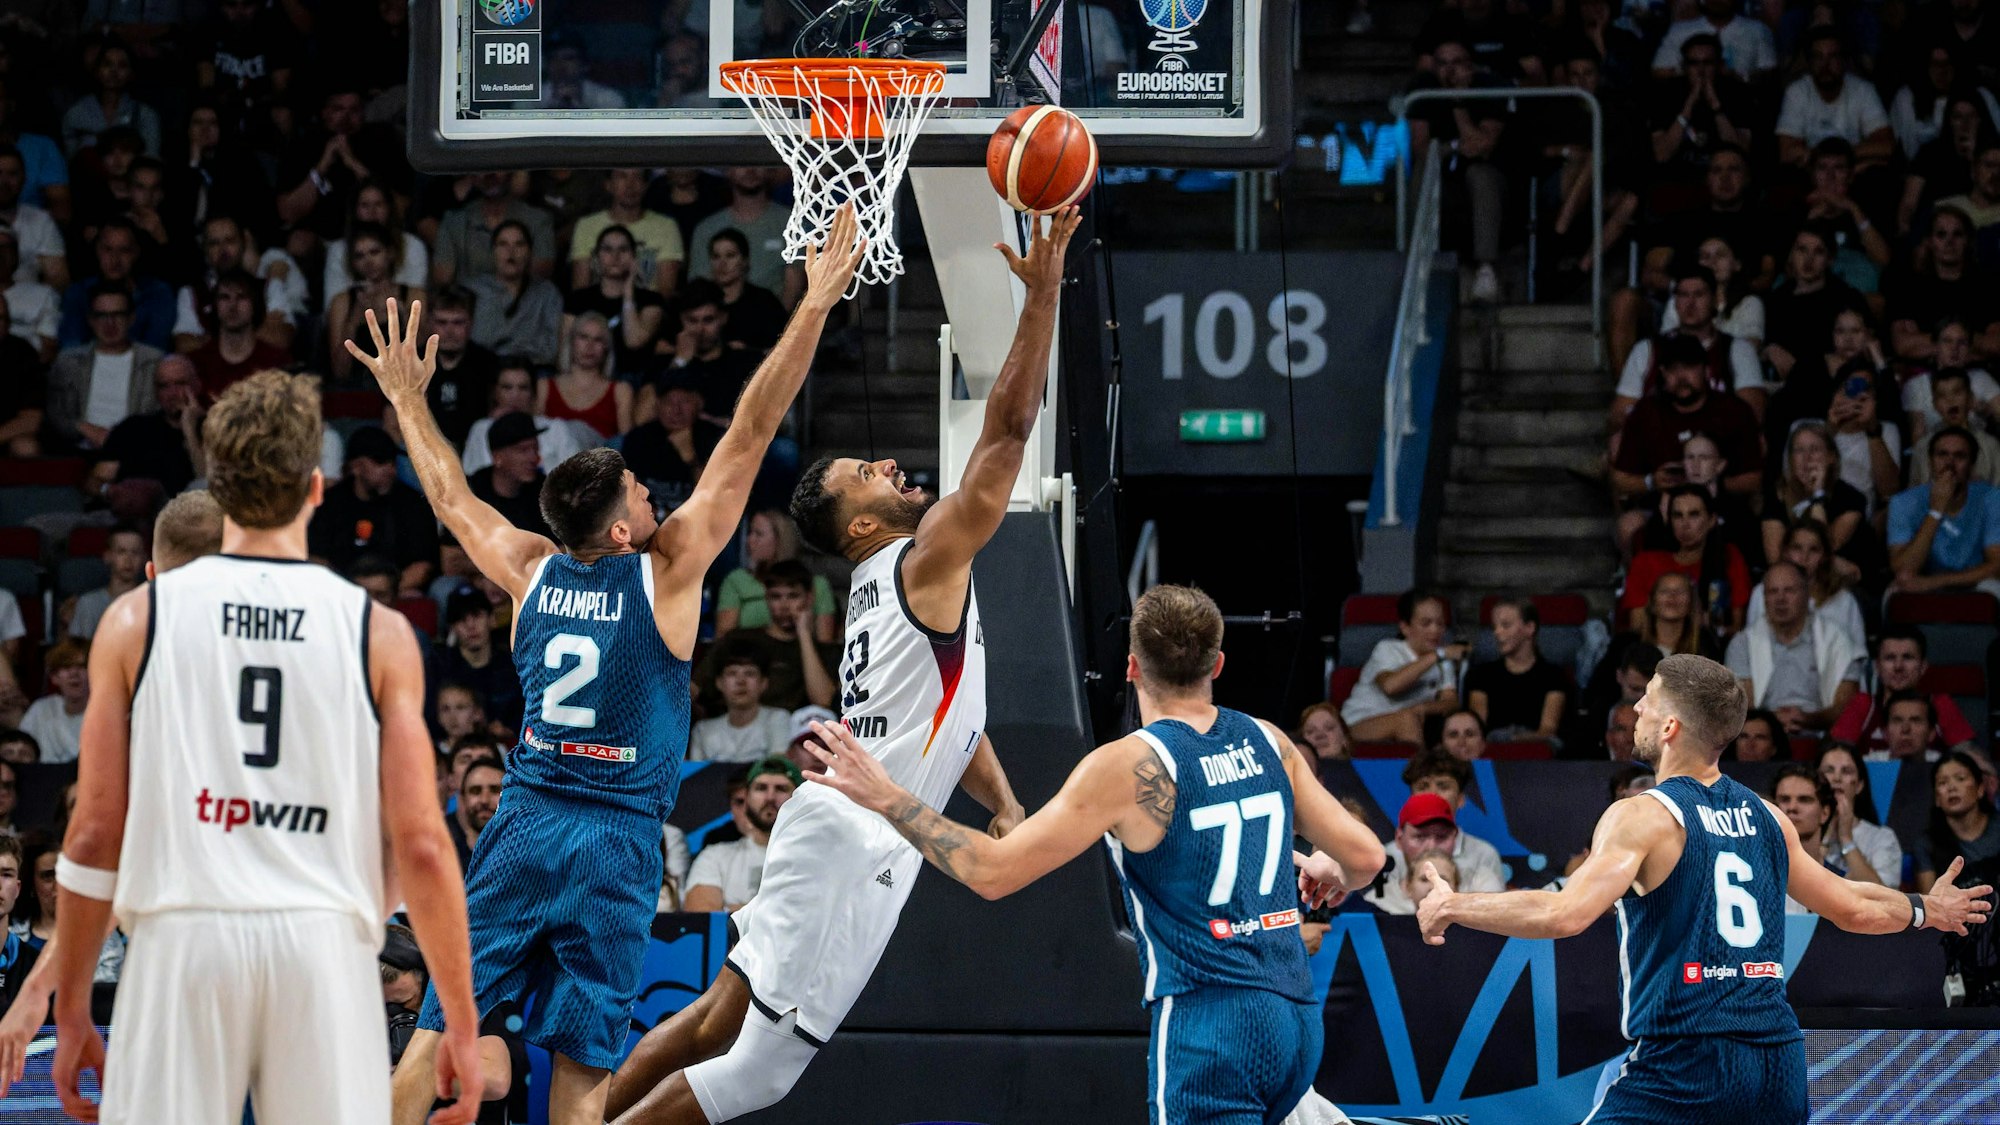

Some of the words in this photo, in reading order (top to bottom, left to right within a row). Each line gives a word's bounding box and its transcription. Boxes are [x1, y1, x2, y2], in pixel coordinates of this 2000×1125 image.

[484, 42, 530, 65] FIBA
[1162, 61, 1183, 71] FIBA
[504, 83, 534, 91] Basketball
[1117, 72, 1228, 92] EUROBASKET
[1143, 290, 1328, 379] 108
[222, 602, 305, 642] FRANZ
[537, 585, 623, 622] KRAMPELJ
[541, 633, 600, 729] 2
[237, 665, 283, 769] 9
[575, 745, 620, 758] SPAR
[1199, 738, 1264, 787] DONČIĆ
[196, 788, 329, 834] tipwin
[1189, 791, 1286, 906] 77
[1714, 851, 1764, 948] 6
[1230, 918, 1260, 936] trigla
[1703, 965, 1738, 981] triglav
